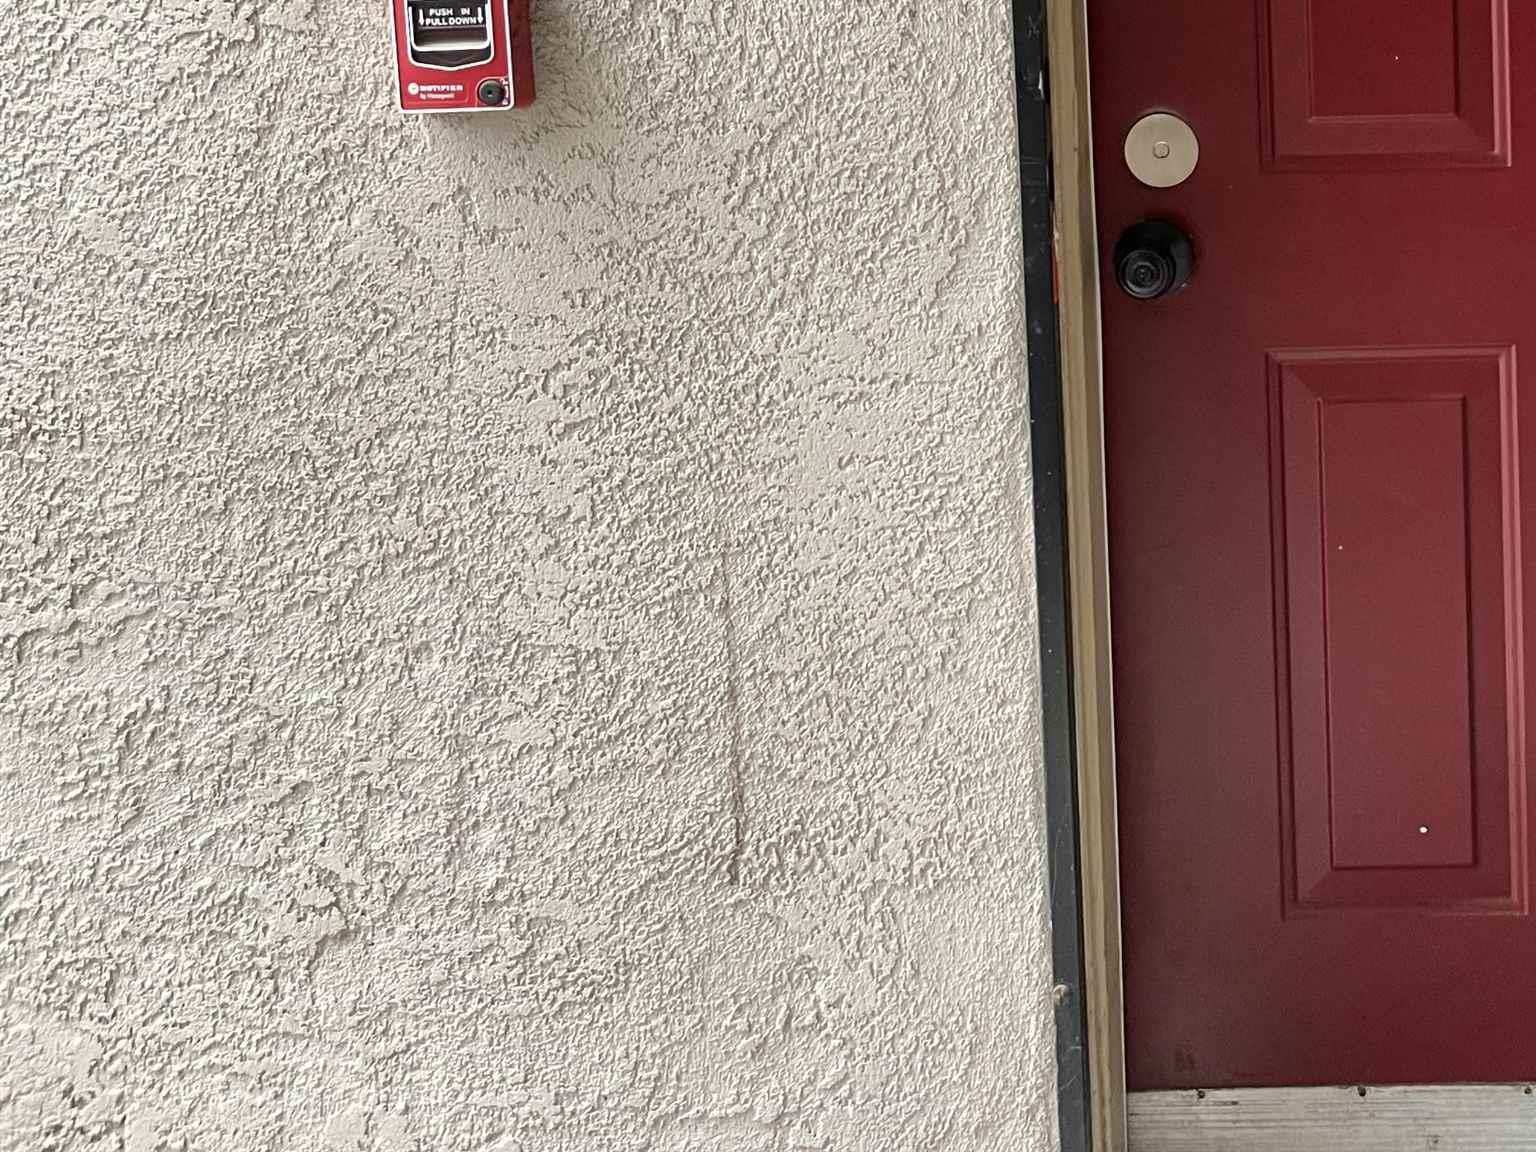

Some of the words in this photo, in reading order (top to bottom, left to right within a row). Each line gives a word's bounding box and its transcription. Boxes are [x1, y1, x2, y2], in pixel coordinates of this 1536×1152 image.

[429, 8, 453, 16] PUSH
[460, 7, 470, 15] IN
[425, 17, 448, 25] PULL
[449, 16, 477, 25] DOWN
